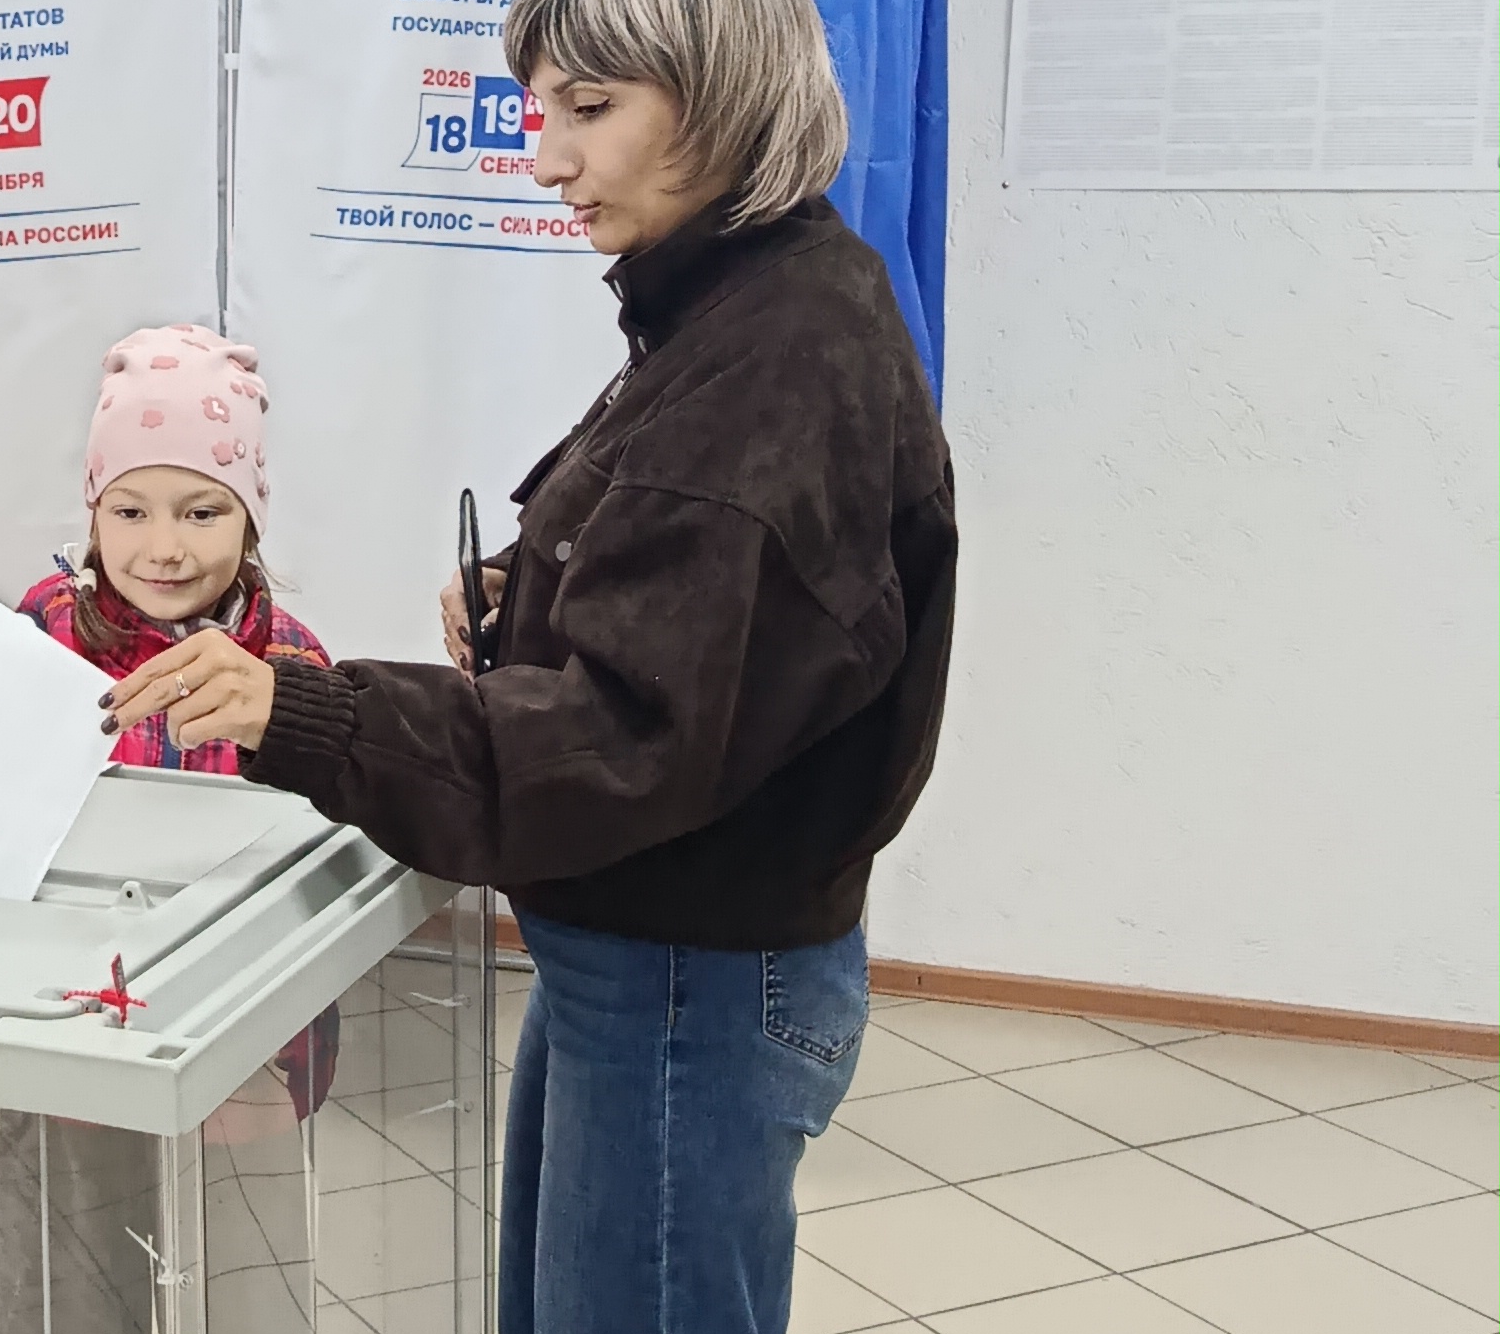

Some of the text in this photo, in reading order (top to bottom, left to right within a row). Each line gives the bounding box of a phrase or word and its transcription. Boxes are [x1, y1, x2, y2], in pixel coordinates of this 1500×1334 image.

[17, 40, 69, 61] ДУМЫ
[423, 69, 471, 88] 2026
[426, 114, 466, 153] 18
[480, 94, 522, 135] 19
[336, 206, 394, 227] ТВОЙ
[402, 210, 473, 231] ГОЛОС
[24, 223, 119, 245] РОССИИ!
